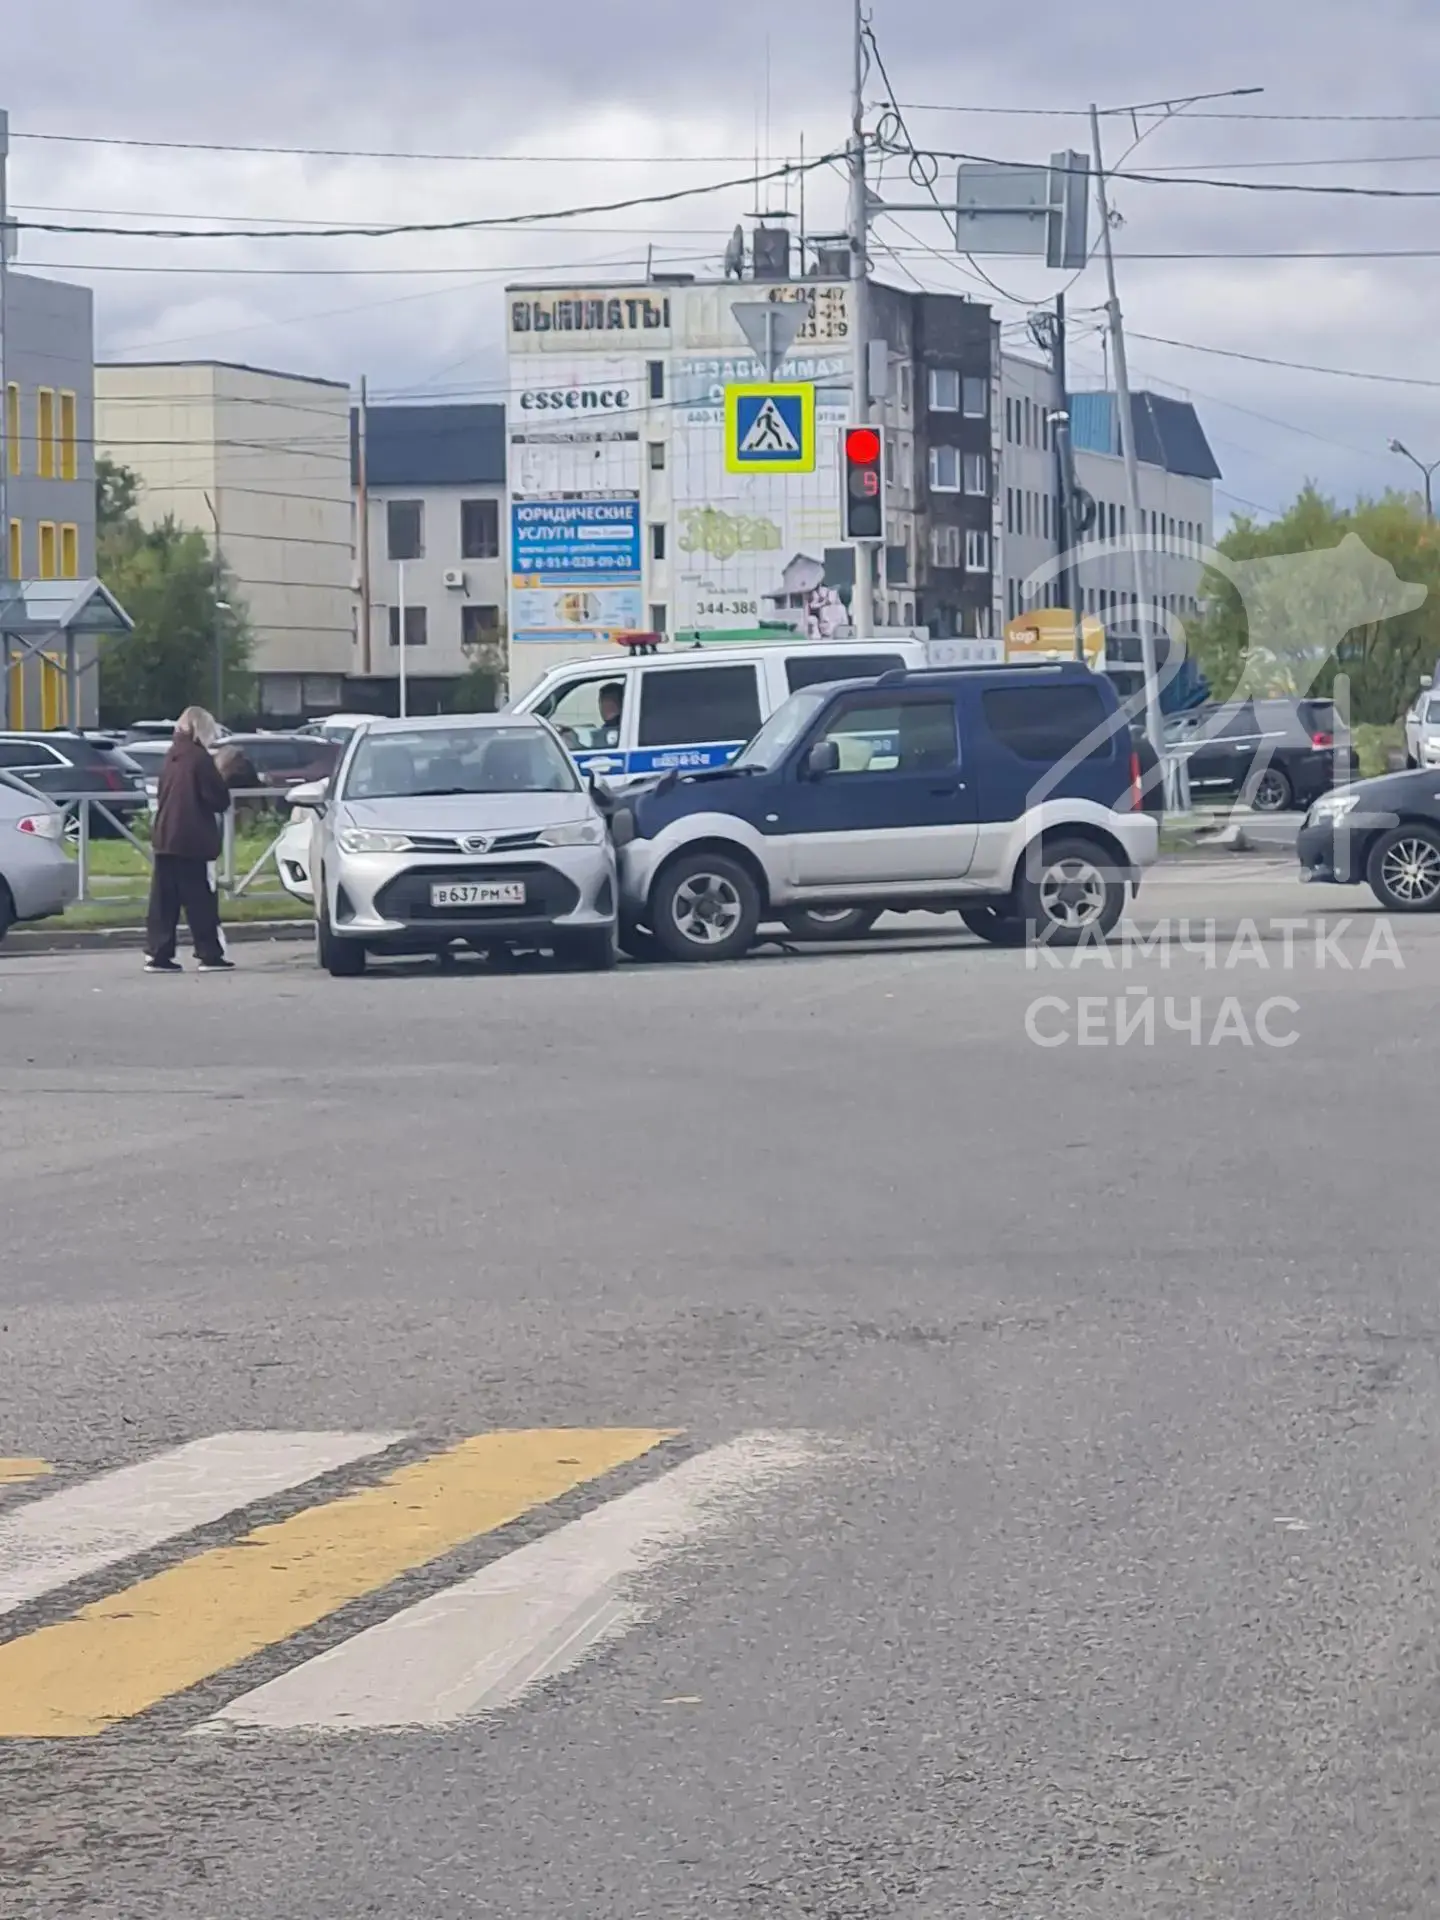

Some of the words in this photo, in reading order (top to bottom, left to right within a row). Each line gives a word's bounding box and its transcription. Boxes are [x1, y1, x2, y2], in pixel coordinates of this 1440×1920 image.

[520, 389, 629, 409] essence
[863, 471, 878, 496] 9
[517, 505, 634, 523] ЮРИДИЧЕСКИЕ
[517, 525, 575, 541] УСЛУГИ
